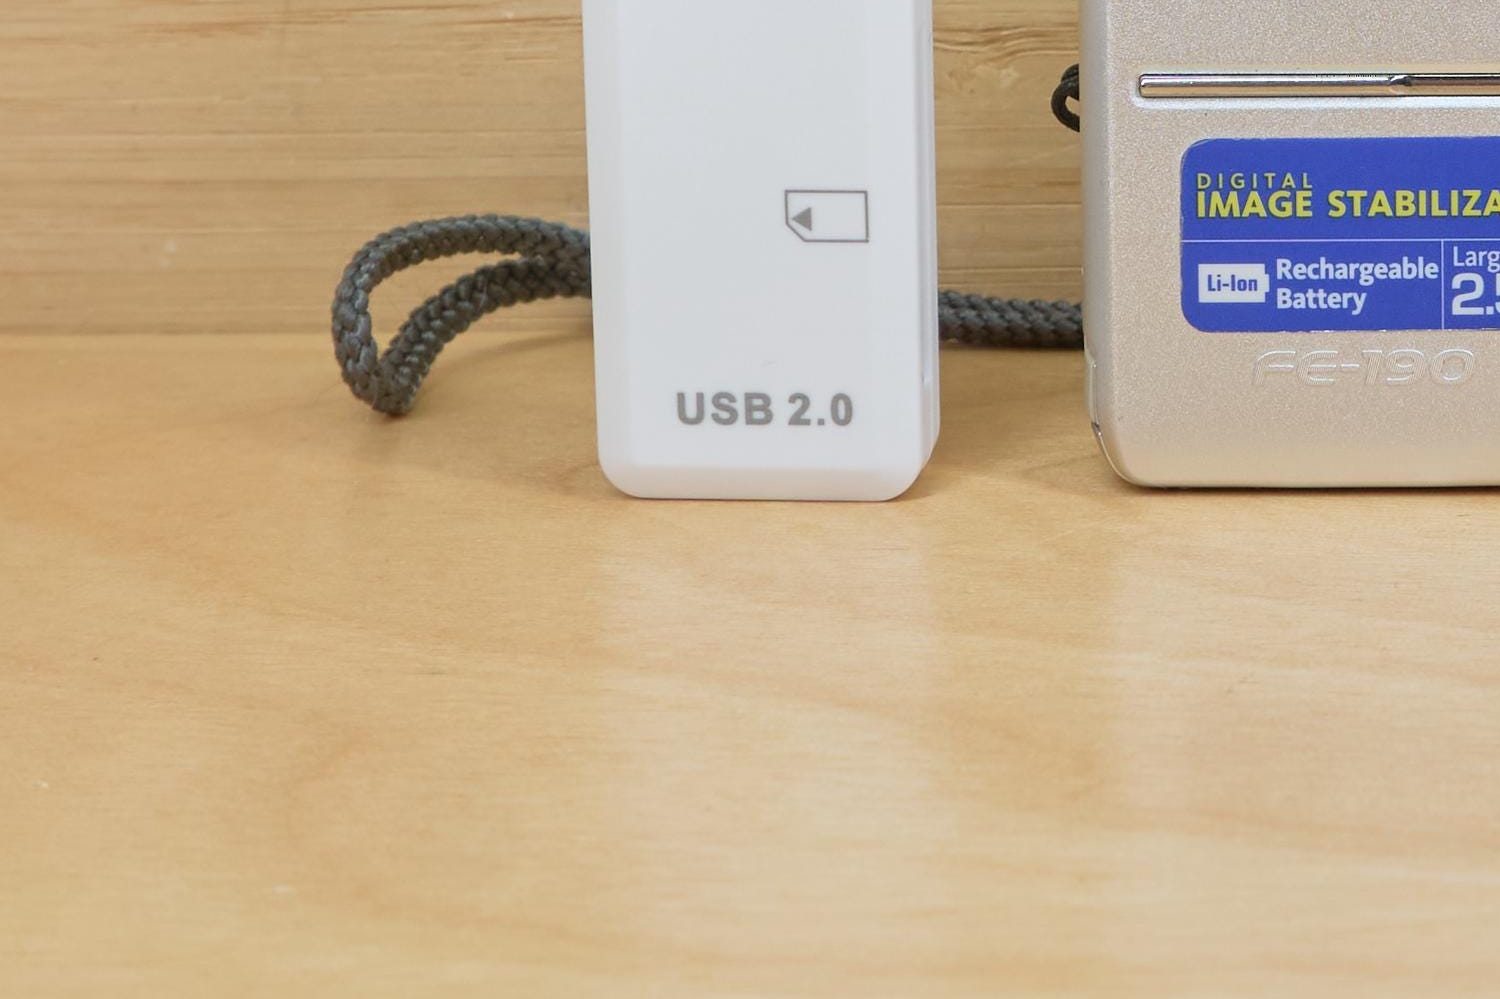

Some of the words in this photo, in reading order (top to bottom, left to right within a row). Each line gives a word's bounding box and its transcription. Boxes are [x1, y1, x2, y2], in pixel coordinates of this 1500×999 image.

[1196, 172, 1313, 190] DIGITAL
[1196, 190, 1314, 218] IMAGE
[1206, 275, 1259, 293] Li-Ion
[1276, 256, 1439, 285] Rechargeable
[1276, 287, 1368, 315] Battery
[1251, 348, 1476, 386] FE-190
[676, 391, 774, 427] USB
[788, 391, 854, 427] 2.0
